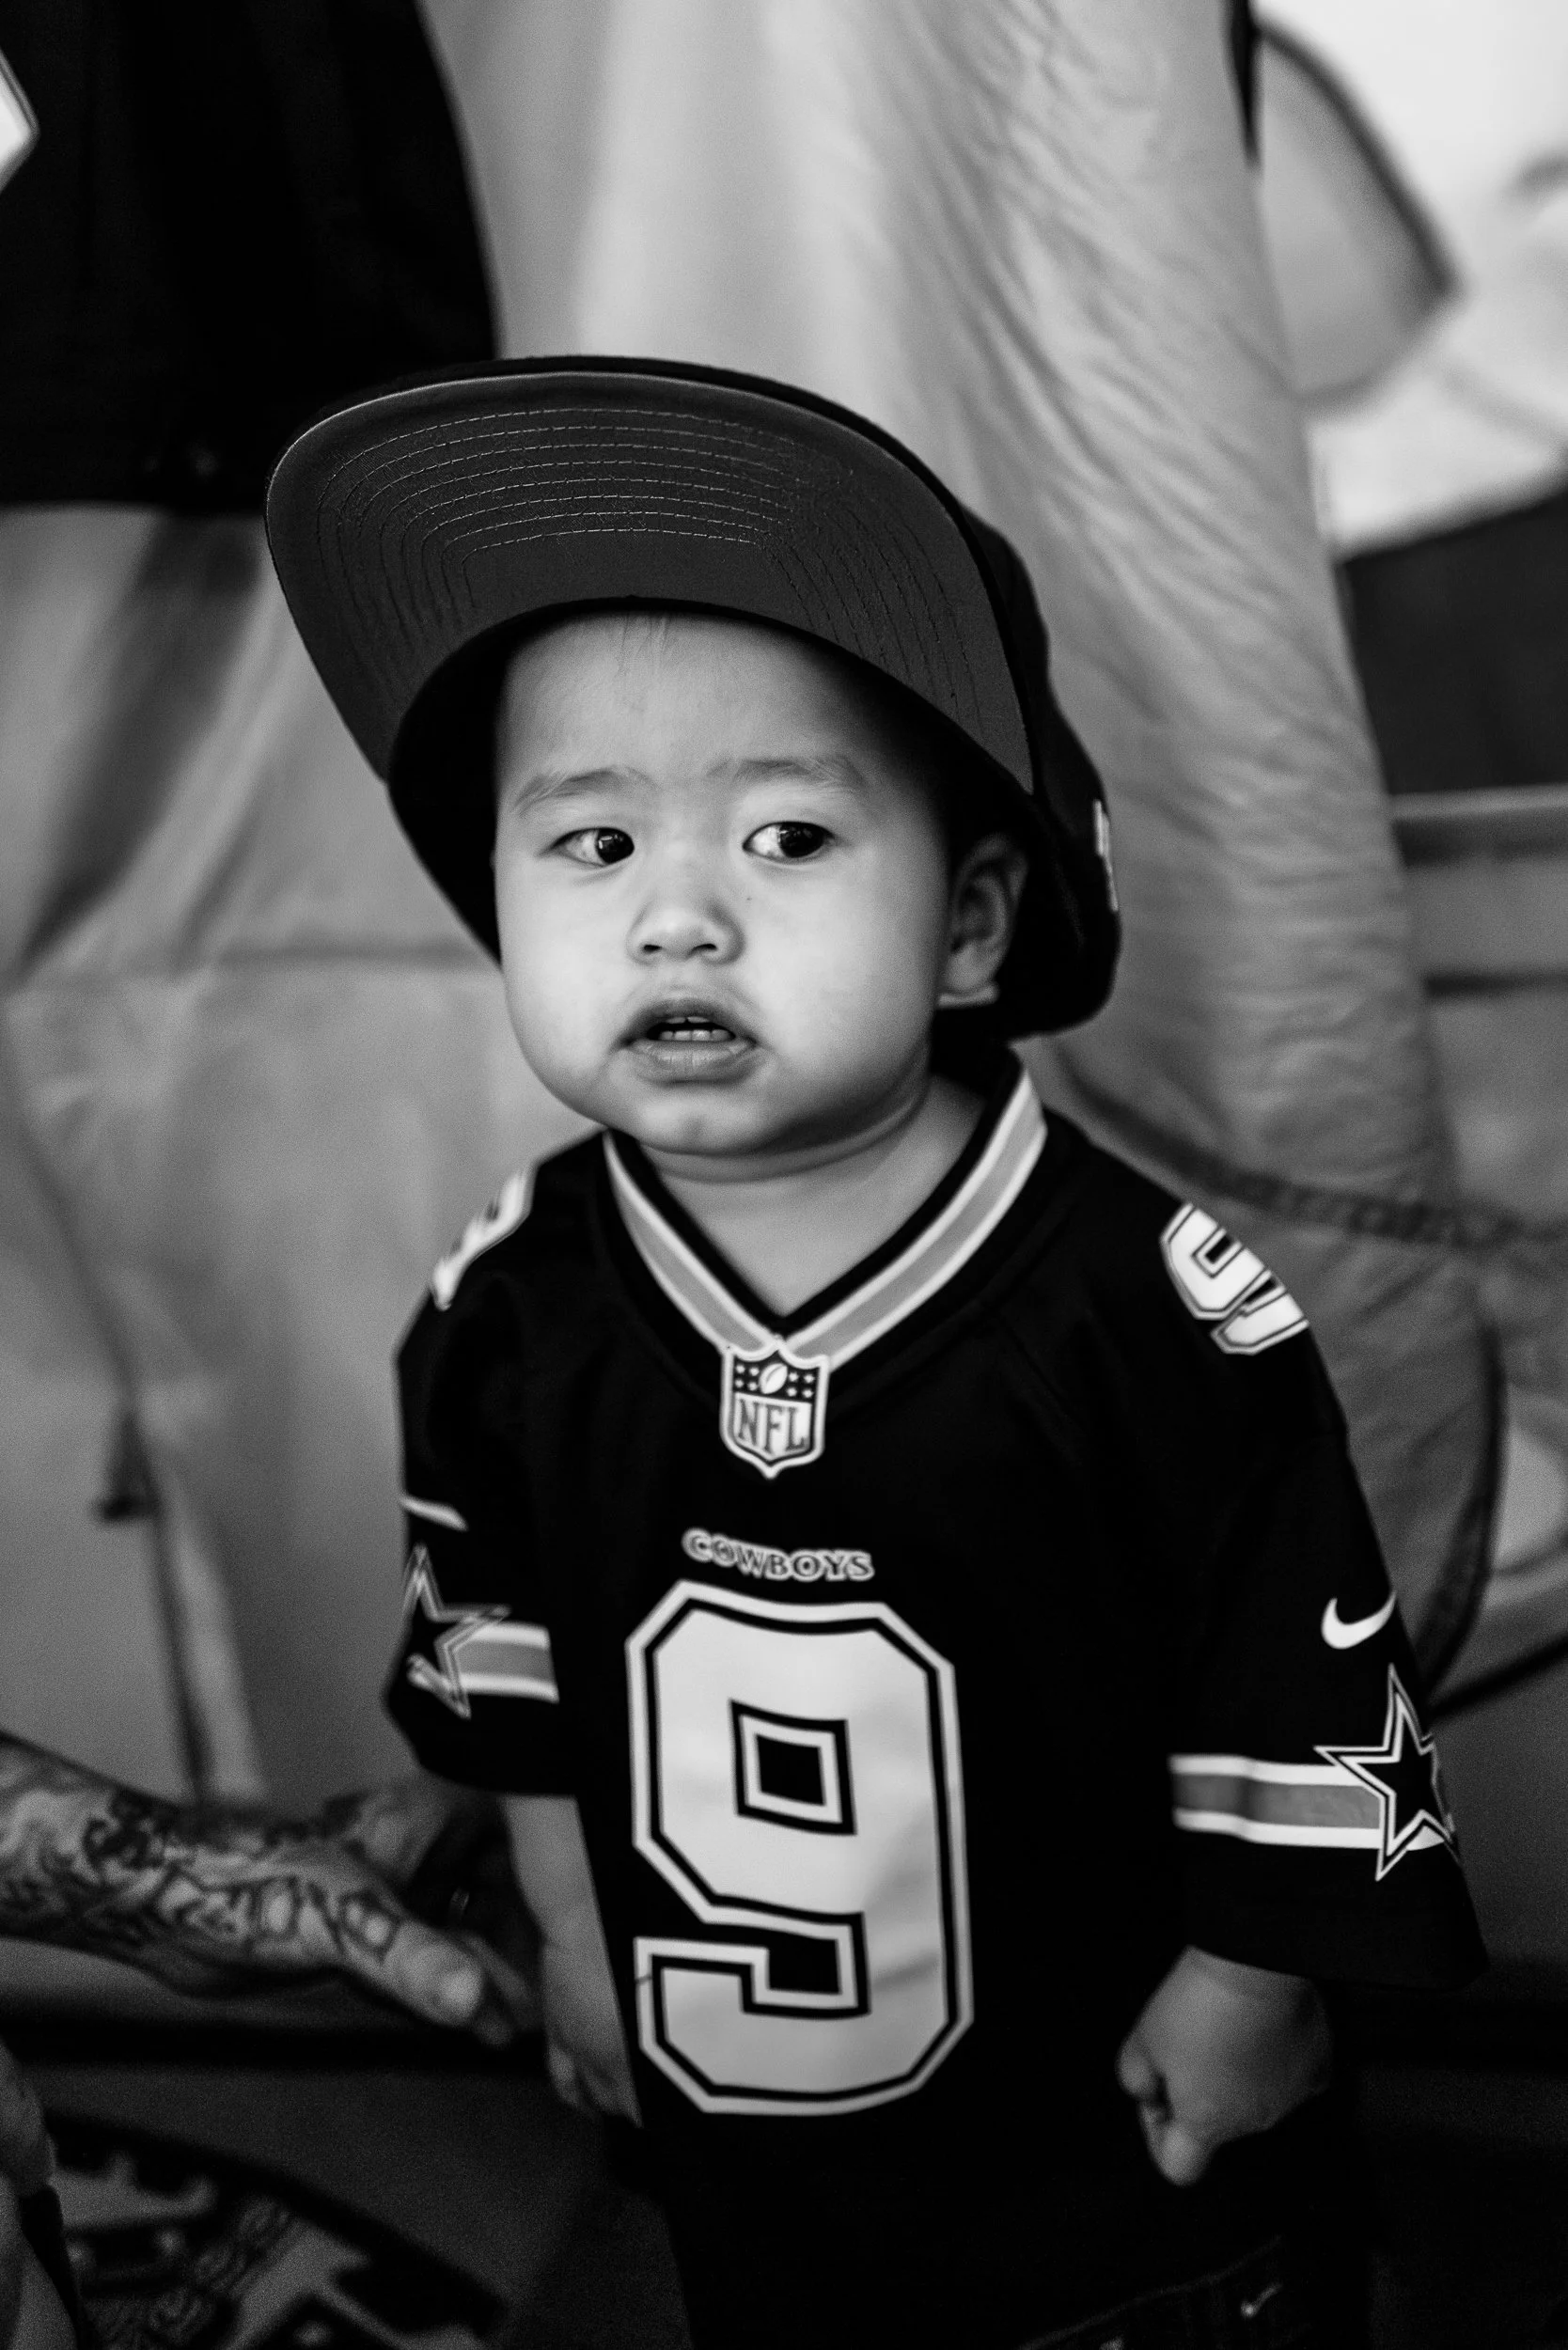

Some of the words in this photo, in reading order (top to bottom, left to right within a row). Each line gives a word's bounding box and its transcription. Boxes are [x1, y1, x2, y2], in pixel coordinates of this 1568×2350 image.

[737, 1398, 810, 1453] NFL
[681, 1527, 875, 1582] COWBOYS
[624, 1579, 974, 2116] 9
